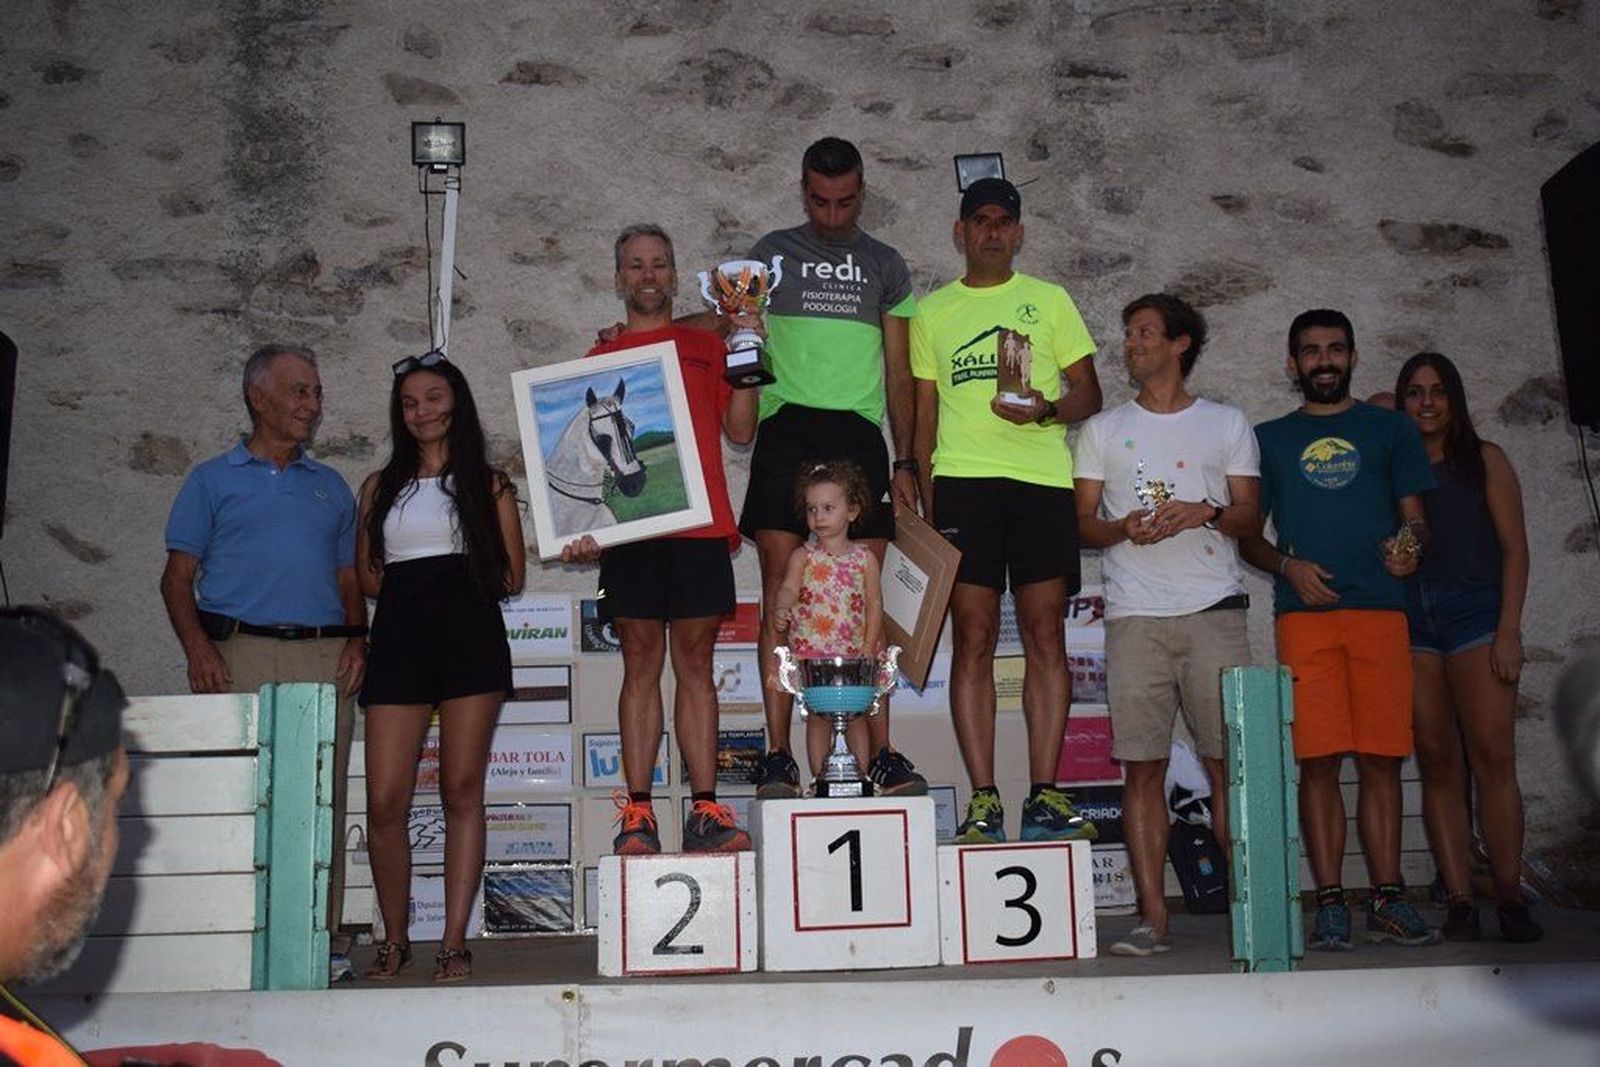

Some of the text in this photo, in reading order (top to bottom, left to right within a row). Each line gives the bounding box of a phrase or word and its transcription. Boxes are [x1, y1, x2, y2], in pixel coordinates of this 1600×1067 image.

[802, 291, 861, 303] FISIOTERAPIA
[951, 351, 996, 369] XÁLI
[488, 751, 565, 764] BAR TOLA
[827, 829, 863, 912] 1
[652, 872, 704, 954] 2
[995, 866, 1042, 947] 3
